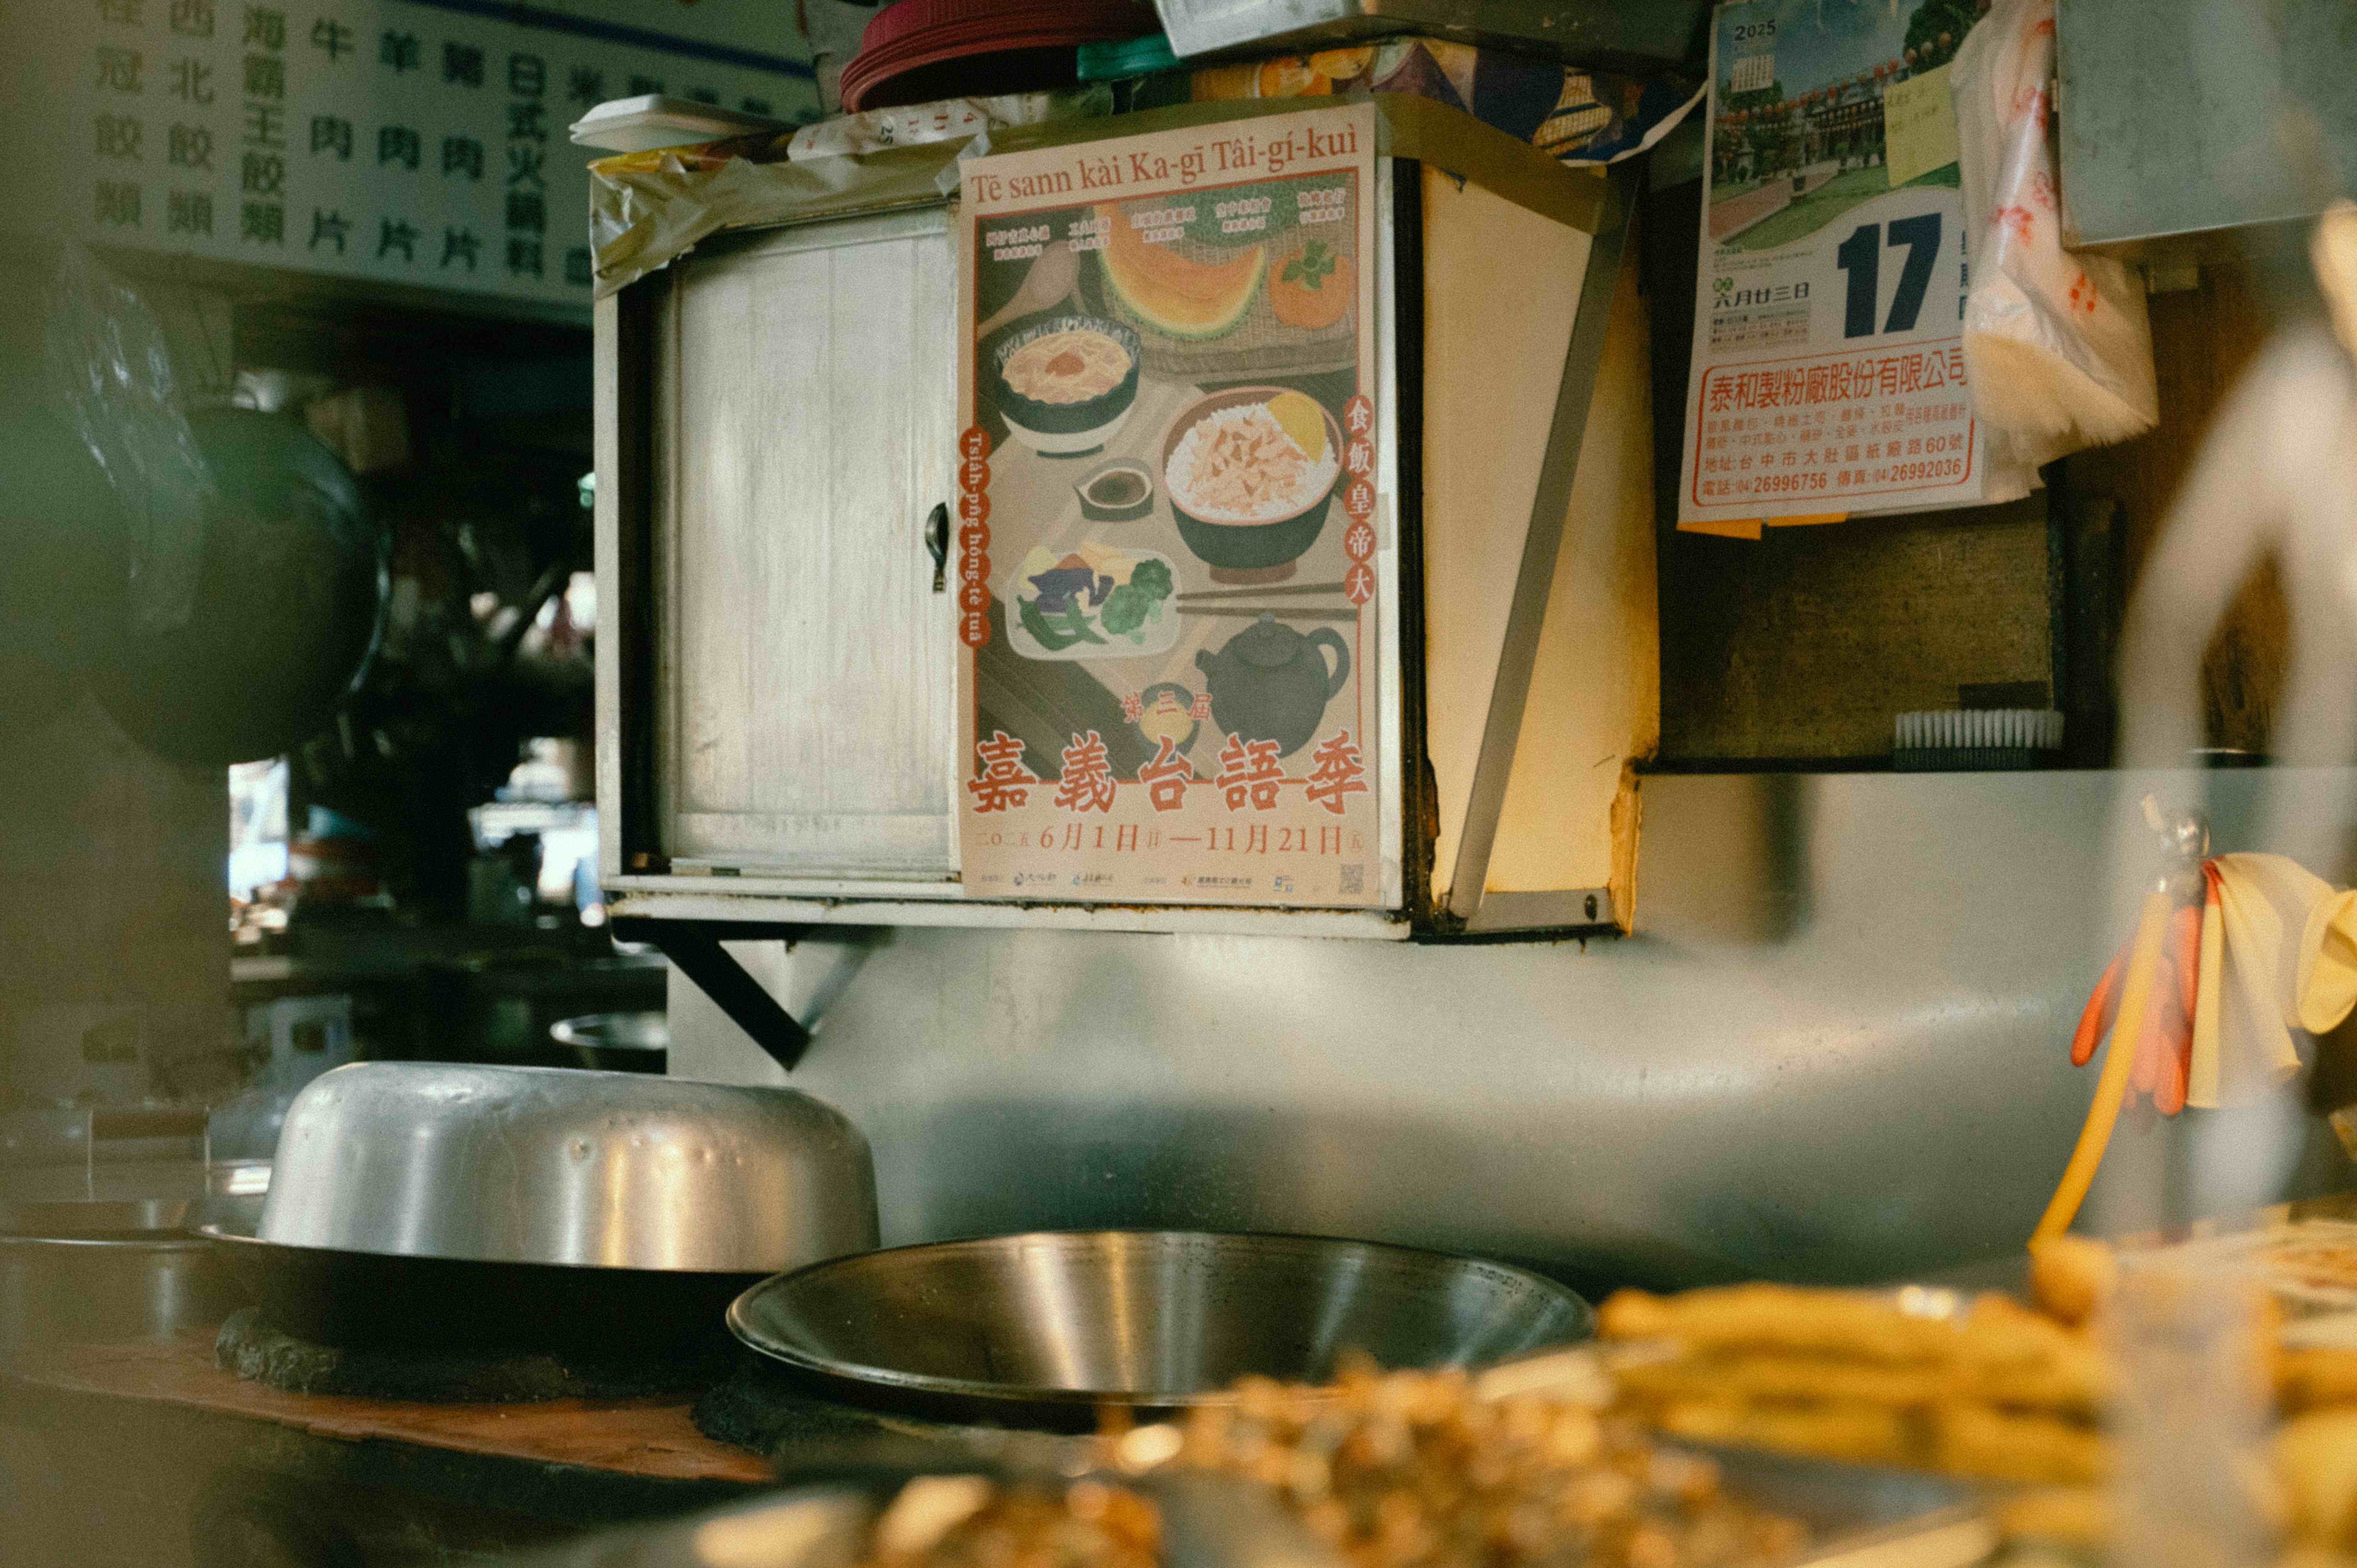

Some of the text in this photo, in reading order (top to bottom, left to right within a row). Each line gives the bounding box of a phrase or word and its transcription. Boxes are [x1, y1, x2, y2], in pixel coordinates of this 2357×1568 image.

[1734, 19, 1776, 41] 2025
[309, 17, 355, 254] 牛肉片
[970, 174, 1002, 203] Tē
[1009, 170, 1072, 198] sann
[1078, 156, 1123, 190] kài
[1129, 146, 1206, 185] Ka-gī
[1713, 282, 1809, 308] 六月廿三日
[1837, 212, 1942, 338] 17
[1710, 347, 1968, 412] 泰和製粉廠股份有限公司
[1348, 399, 1371, 600] 食飯皇帝大
[967, 730, 1368, 814] 嘉義台語季
